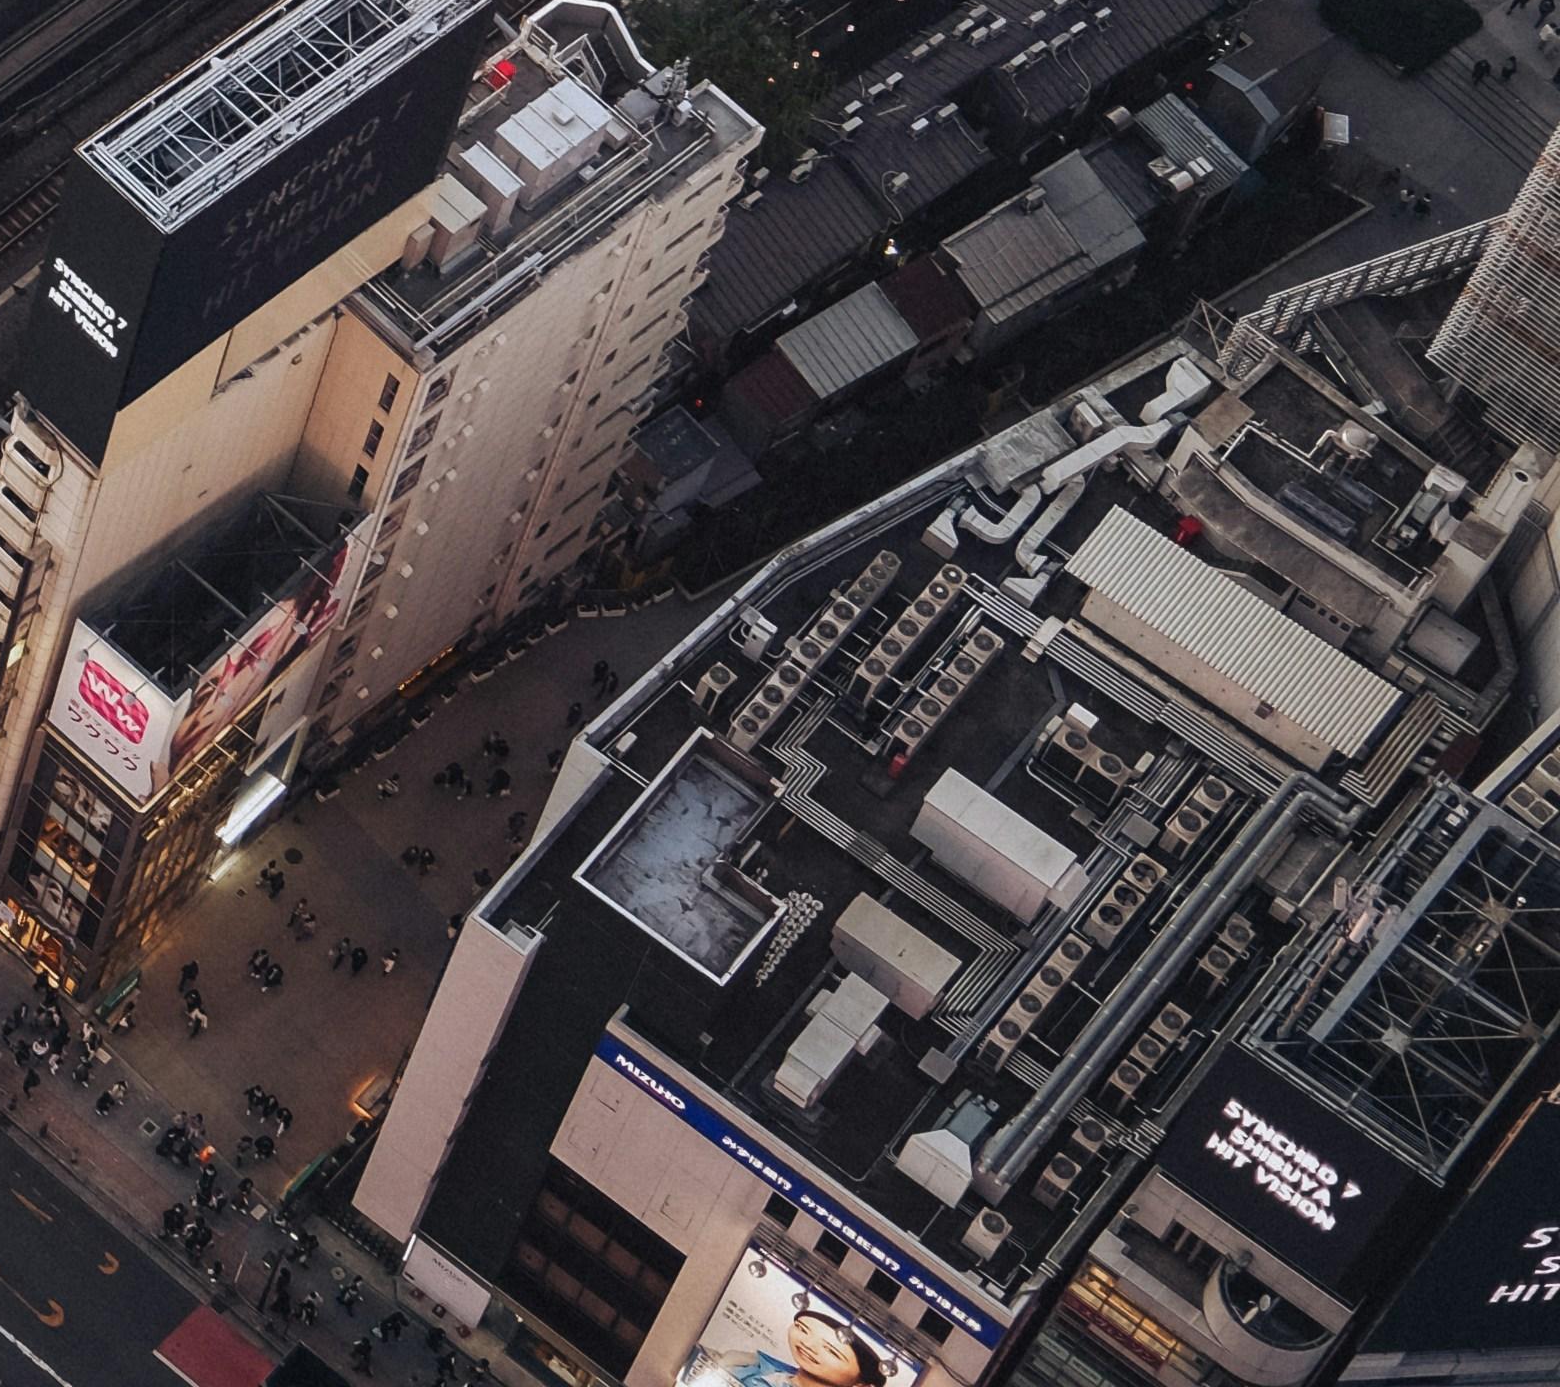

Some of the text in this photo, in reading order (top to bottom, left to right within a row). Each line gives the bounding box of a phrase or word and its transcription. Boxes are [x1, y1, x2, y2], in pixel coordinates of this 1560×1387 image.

[48, 286, 119, 358] HIT VISION
[53, 257, 117, 320] SYNCHRO
[58, 279, 115, 339] SHIBUYA
[615, 1054, 686, 1111] MIZUHO
[1205, 1131, 1337, 1231] HIT VISION
[1223, 1097, 1362, 1200] SYNCHRO 7
[1230, 1126, 1332, 1207] SHIBUYA
